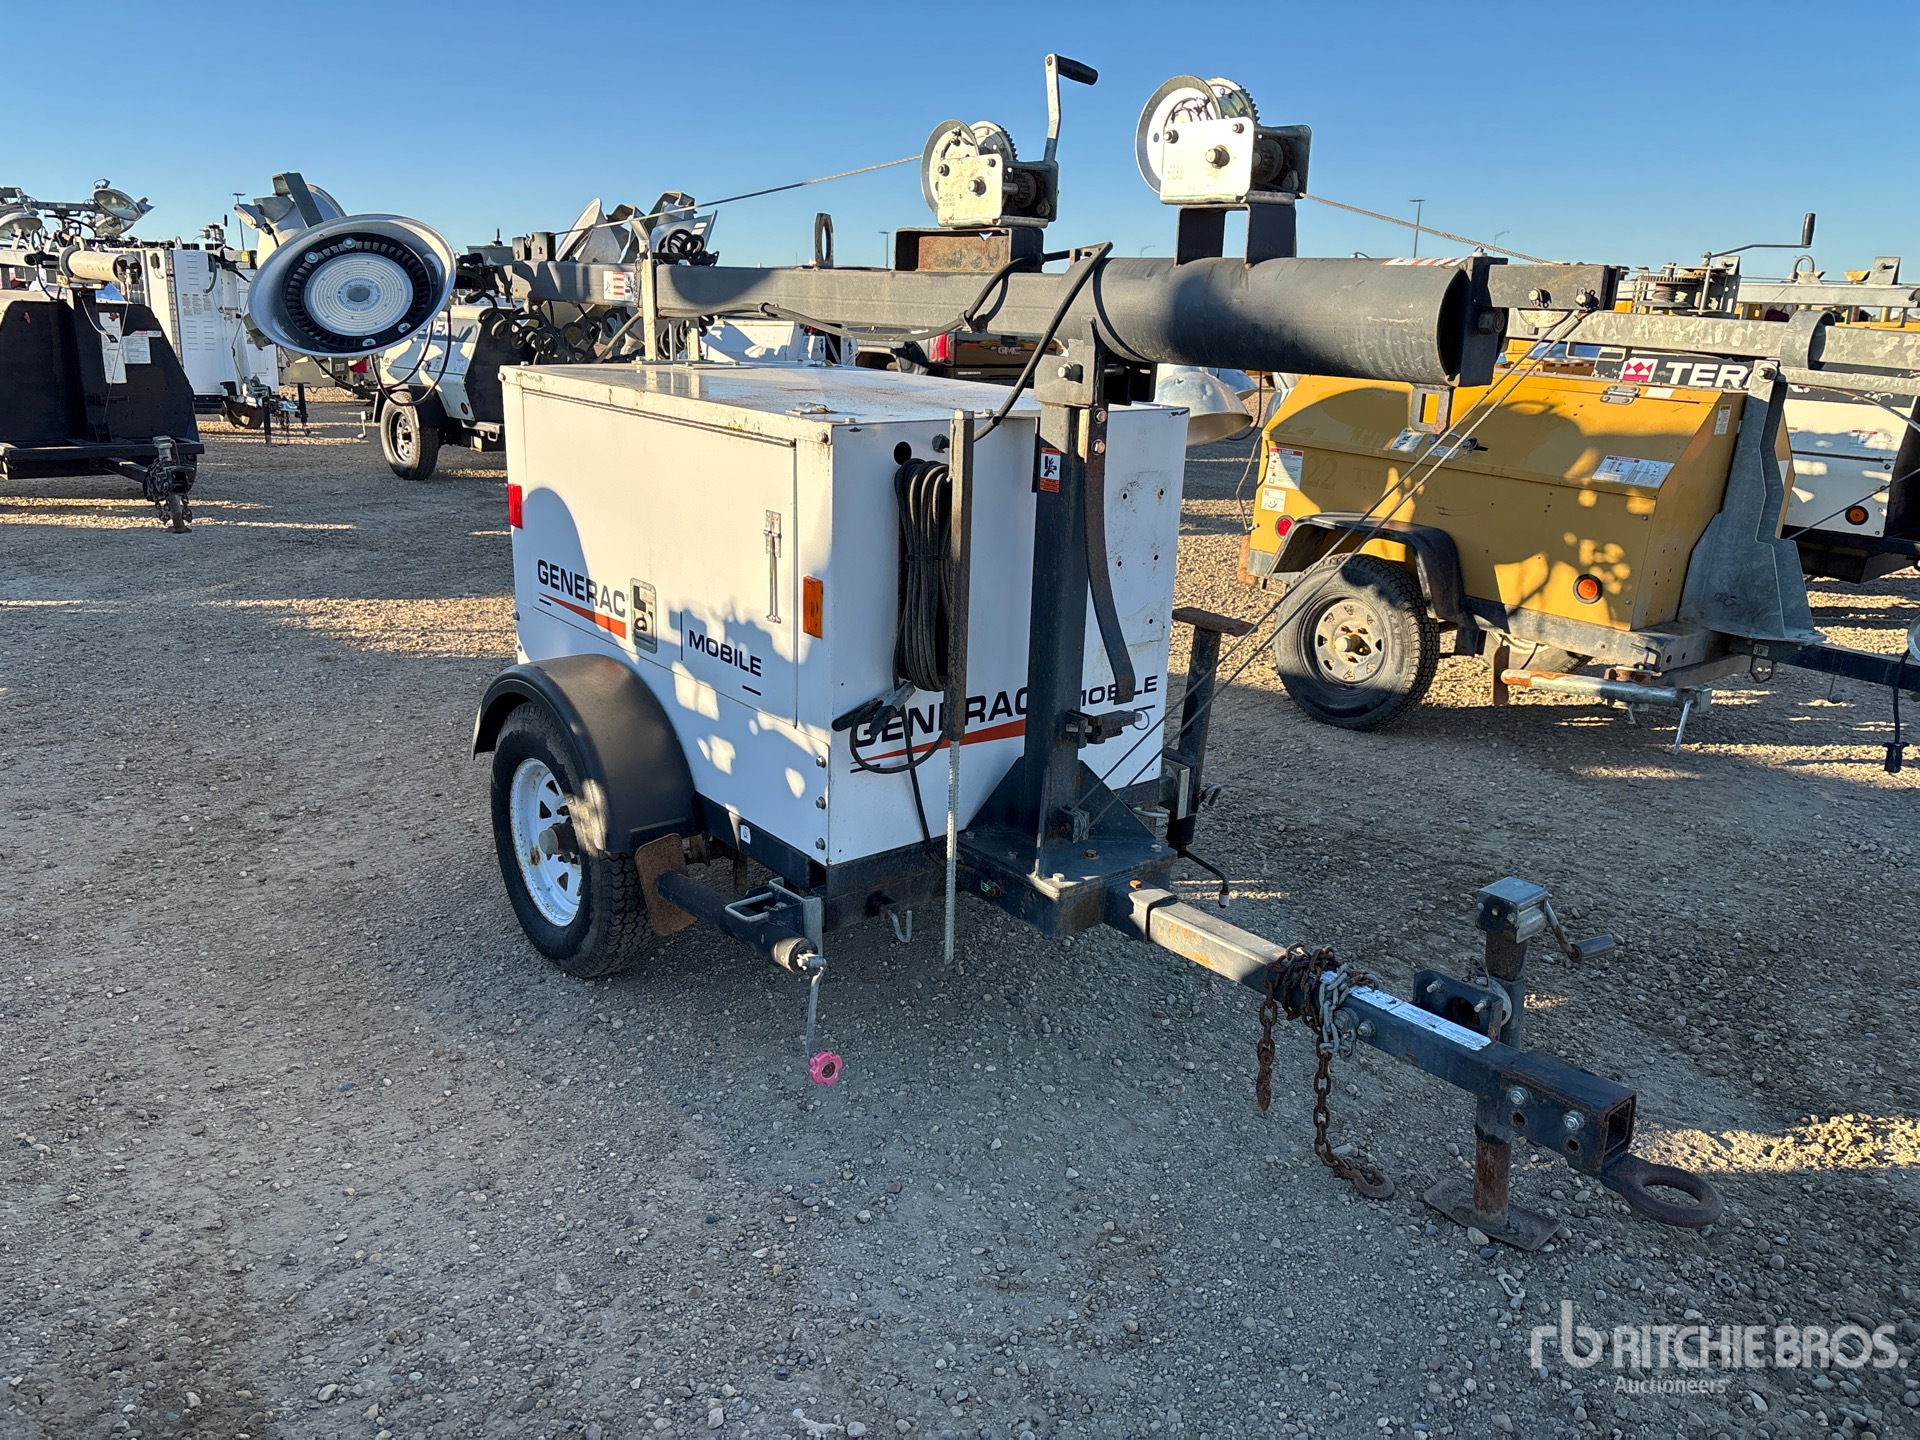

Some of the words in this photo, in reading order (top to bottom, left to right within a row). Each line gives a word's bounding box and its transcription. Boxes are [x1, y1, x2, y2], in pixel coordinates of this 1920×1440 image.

[998, 346, 1021, 355] GMC
[1665, 361, 1803, 392] TER
[537, 559, 626, 618] GENERAC
[688, 629, 762, 677] MOBILE
[1080, 675, 1158, 706] OBE
[855, 686, 1028, 748] GENRAC
